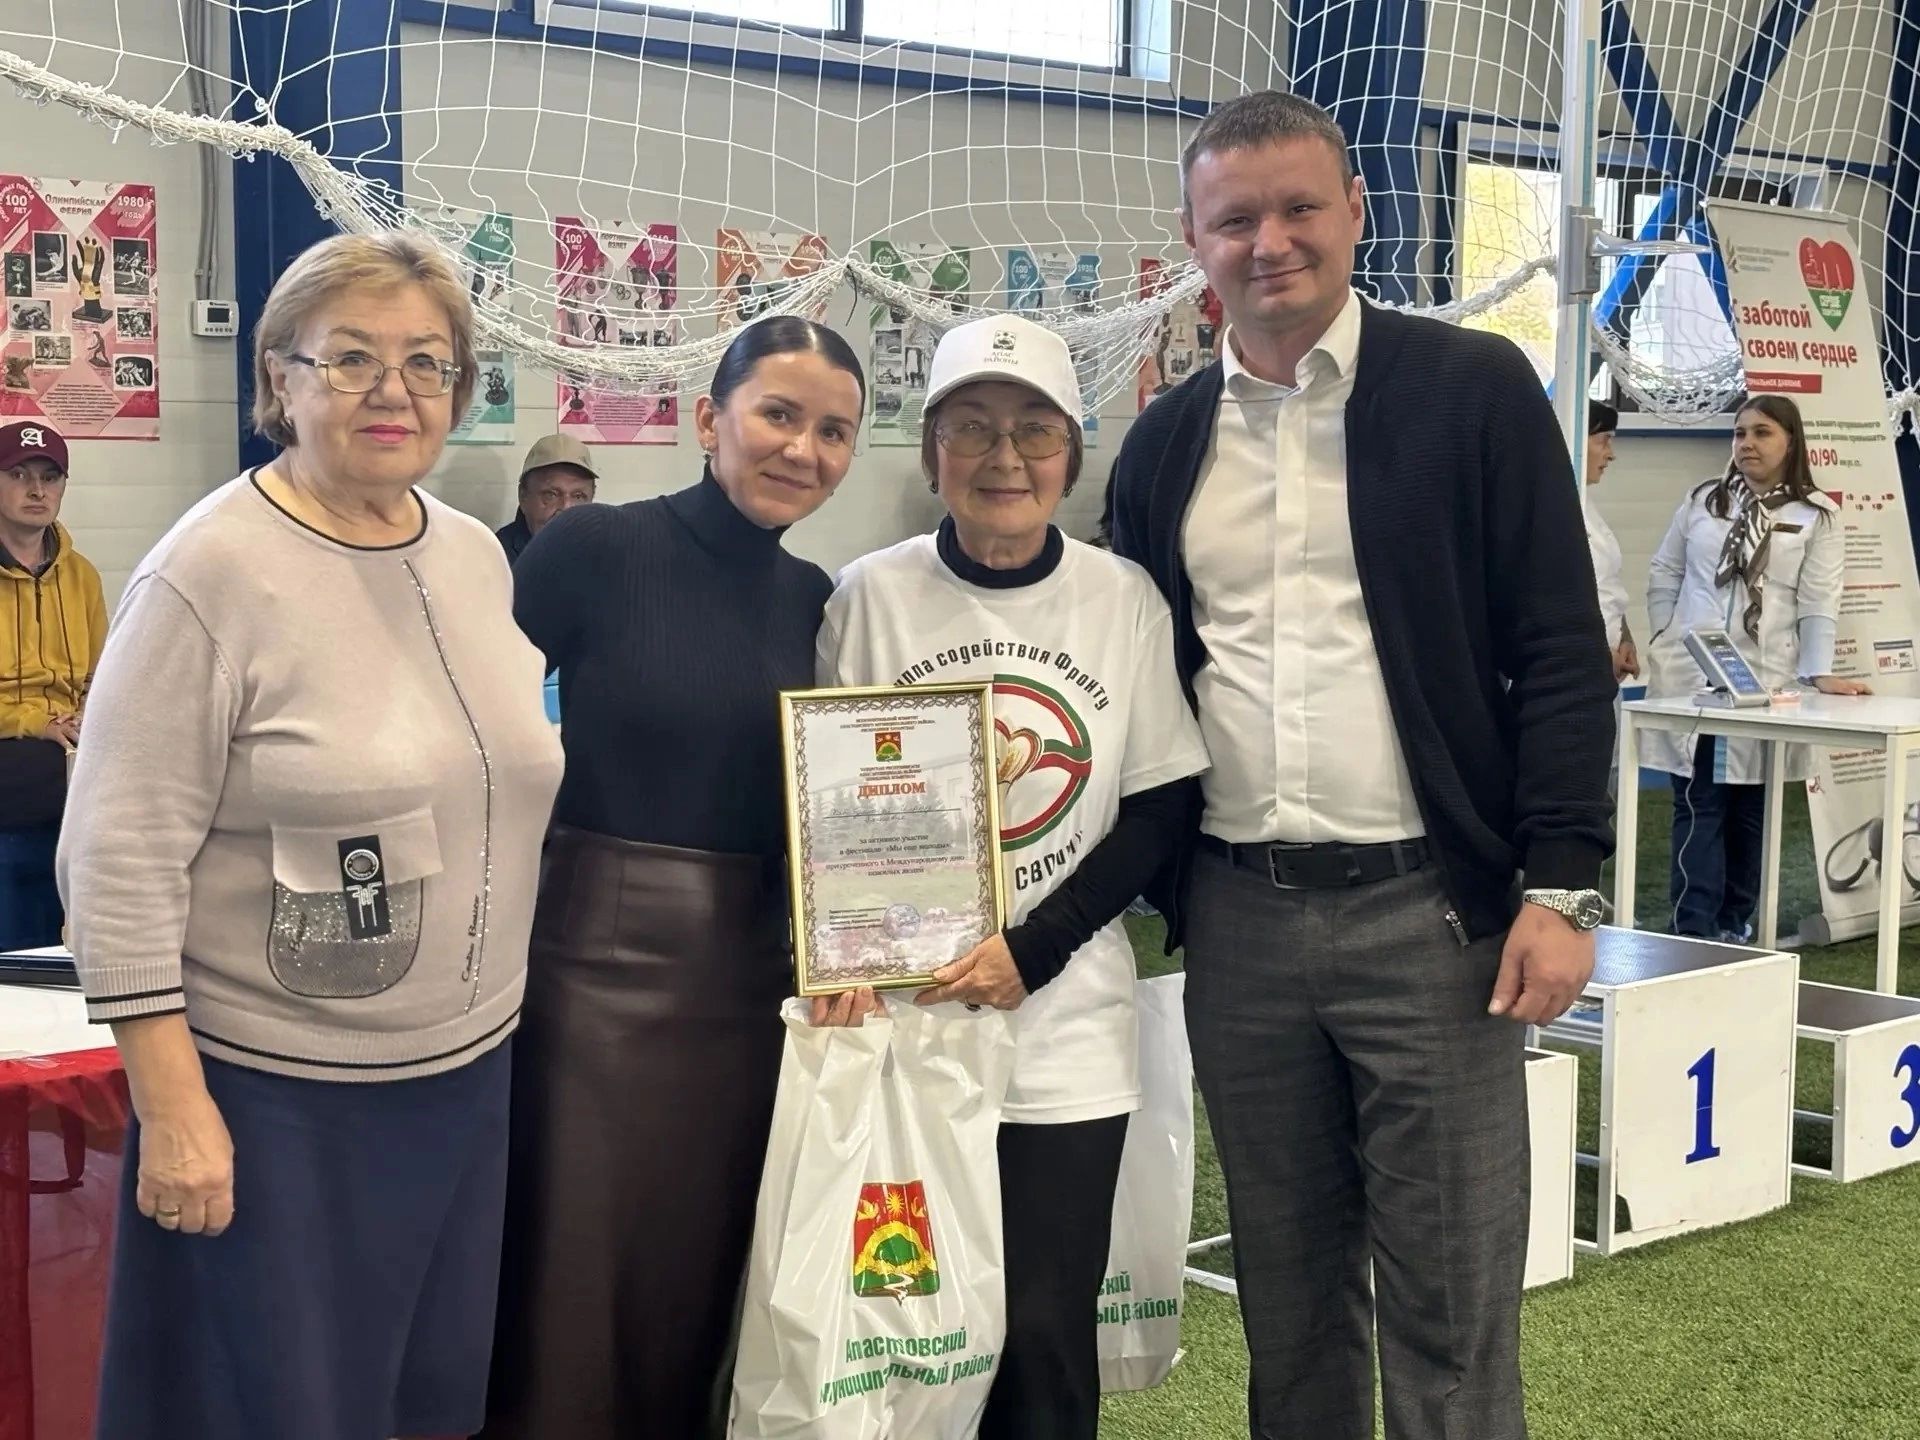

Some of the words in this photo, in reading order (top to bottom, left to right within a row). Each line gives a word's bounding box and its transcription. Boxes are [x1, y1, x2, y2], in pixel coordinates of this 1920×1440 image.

[5, 194, 28, 207] 100
[12, 206, 27, 214] ЛЕТ
[60, 205, 92, 216] ФЕЕРИЯ
[566, 233, 582, 244] 100
[1742, 300, 1812, 329] заботой
[1747, 337, 1799, 362] своем
[1803, 341, 1858, 368] сердце
[20, 427, 47, 448] A
[1806, 448, 1838, 467] 0/90
[936, 638, 1051, 669] содействия
[1054, 652, 1110, 711] Фронту
[857, 782, 926, 799] ДИПЛОМ
[1685, 1046, 1721, 1165] 1
[1890, 1043, 1920, 1149] 3
[1121, 1297, 1178, 1326] район
[846, 1326, 967, 1363] Апастовский
[952, 1353, 996, 1387] район
